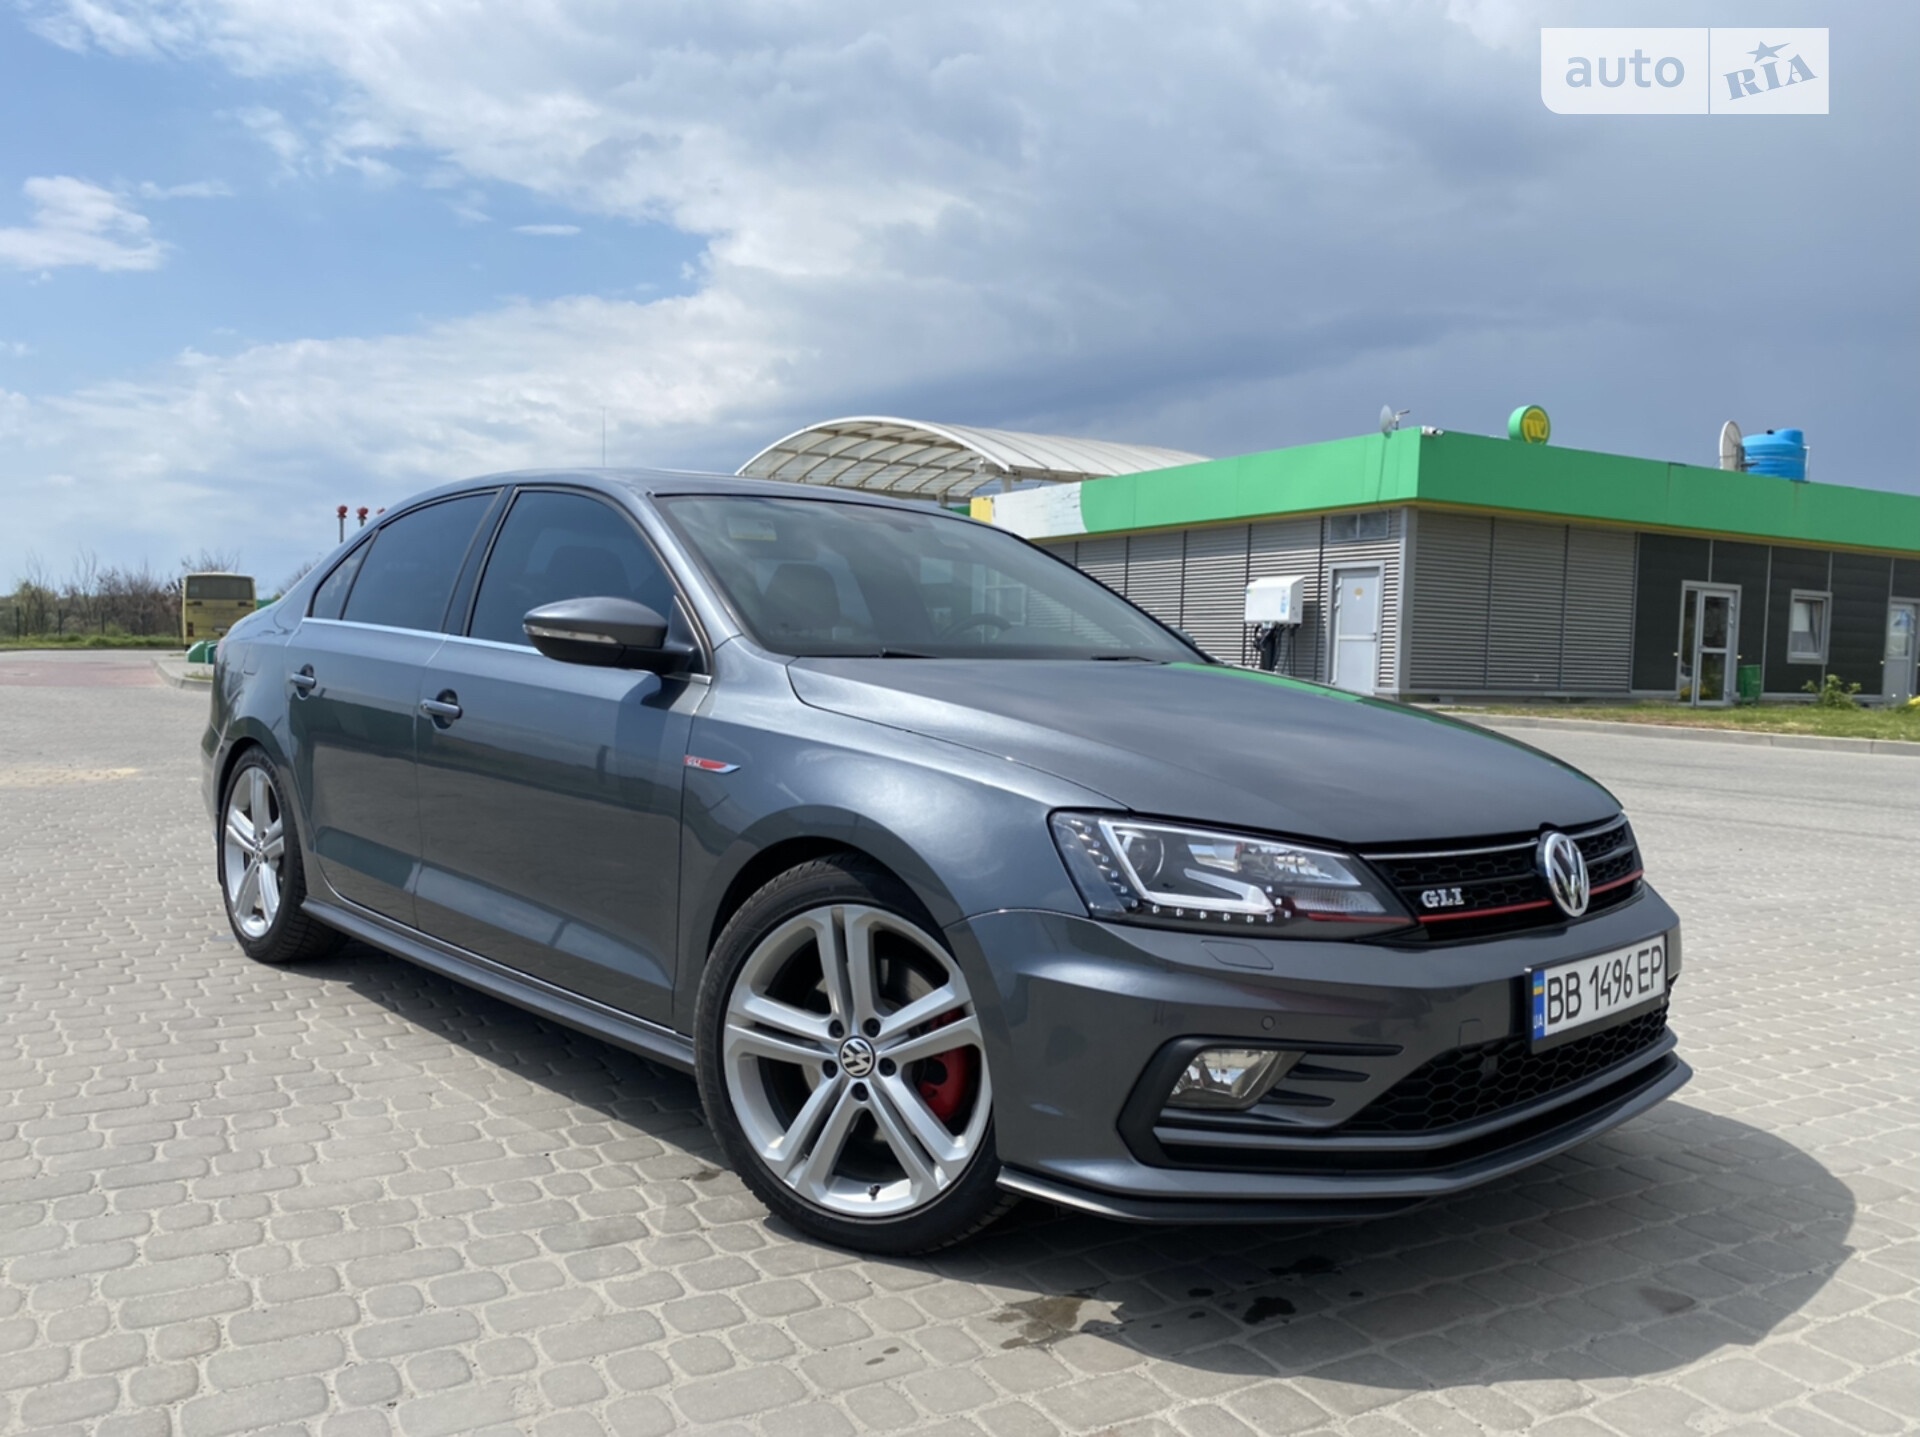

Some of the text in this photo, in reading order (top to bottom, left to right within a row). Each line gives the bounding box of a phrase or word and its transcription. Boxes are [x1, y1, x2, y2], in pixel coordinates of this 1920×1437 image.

[1421, 887, 1465, 908] GLI
[1547, 945, 1664, 1026] BB 1496 EP
